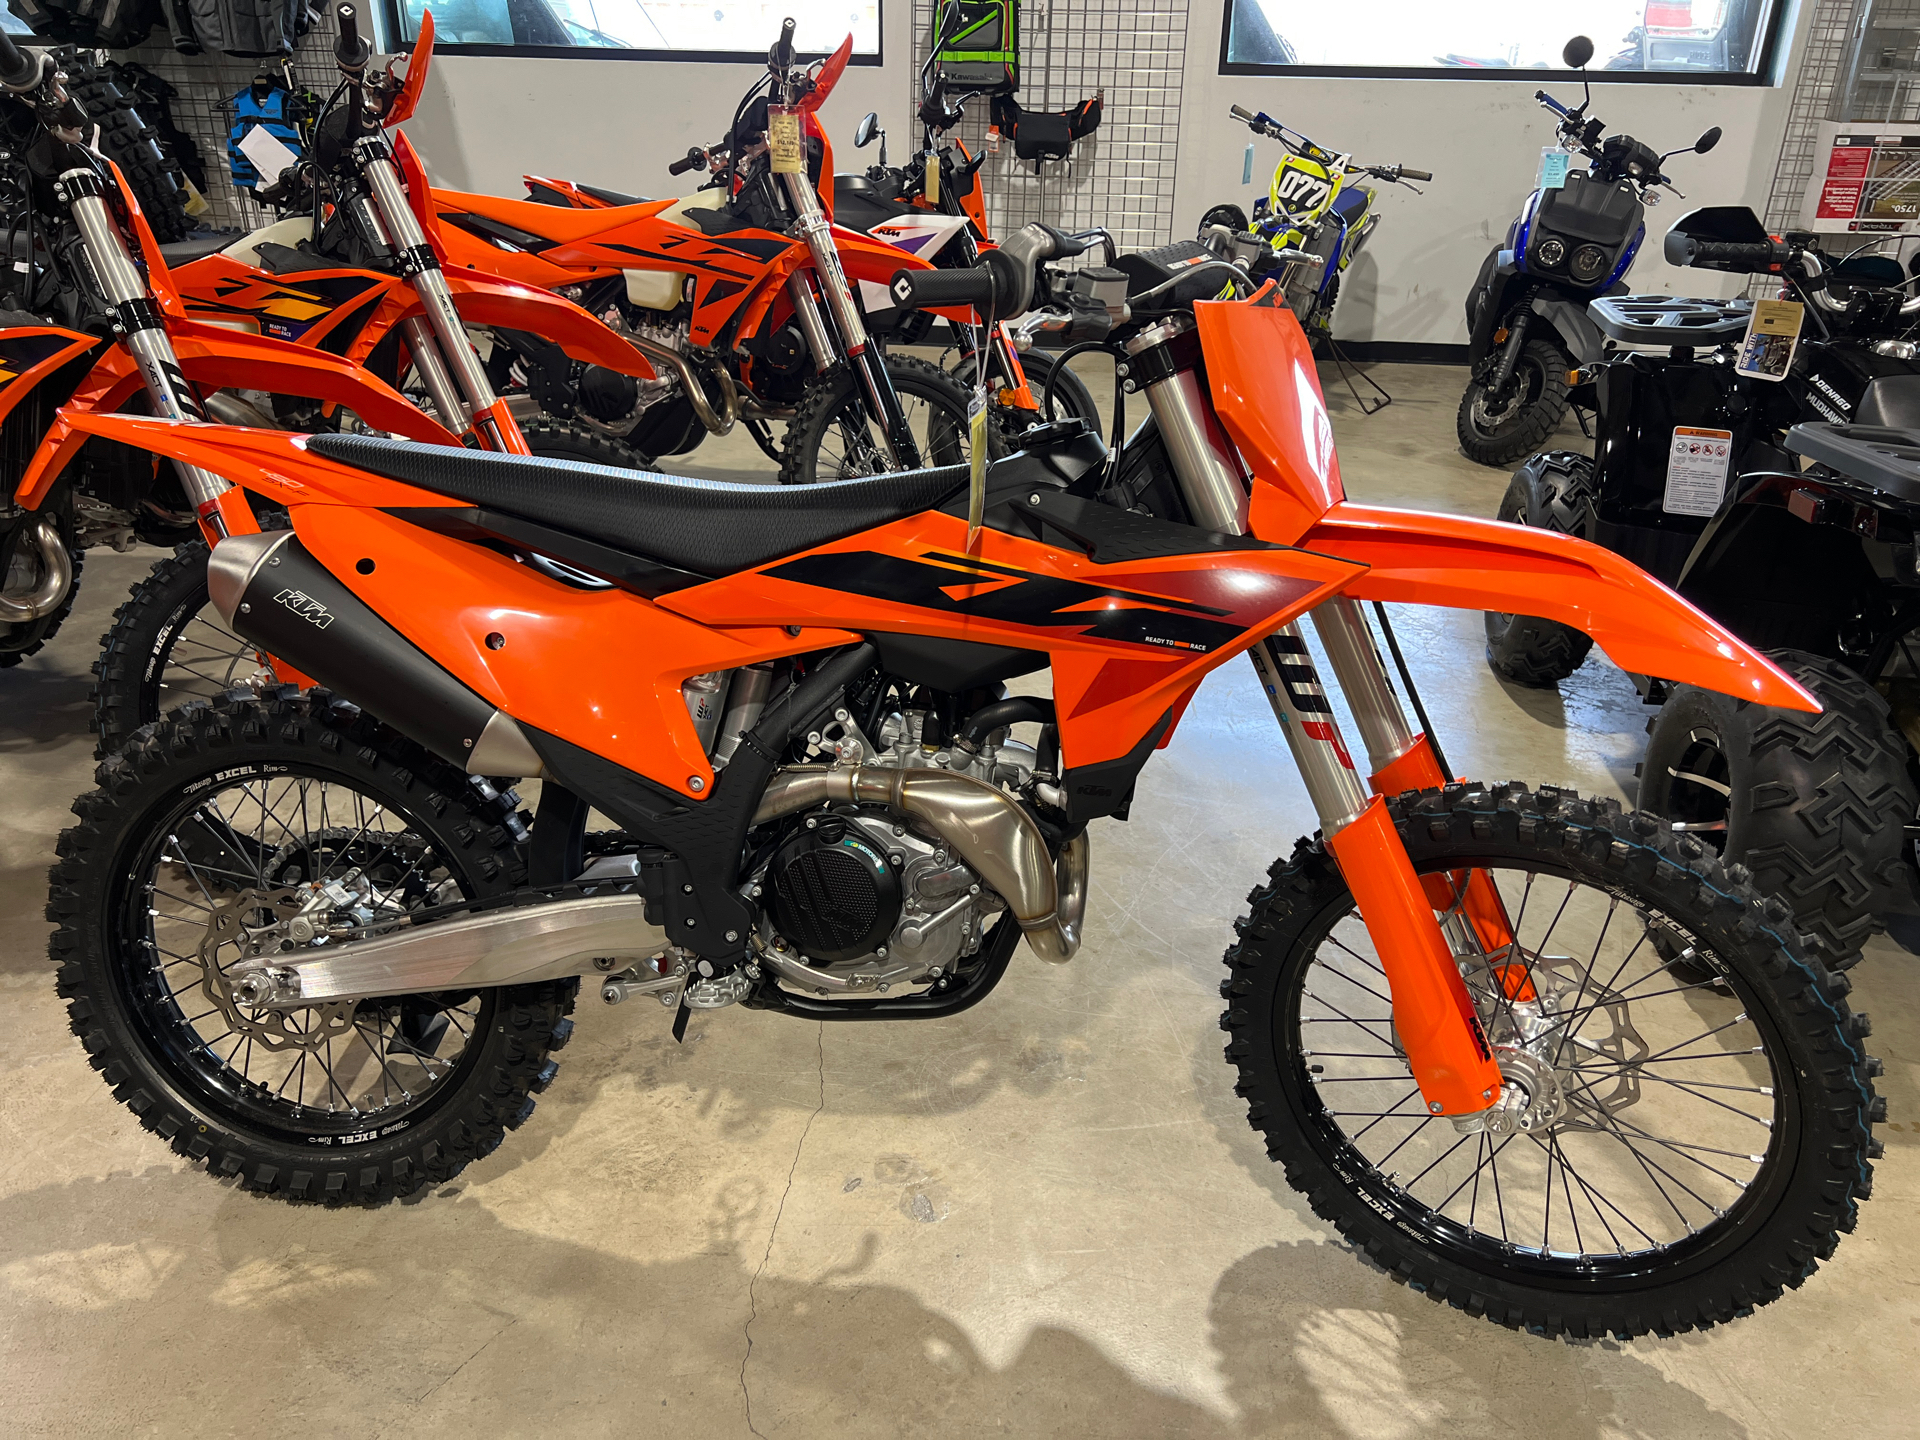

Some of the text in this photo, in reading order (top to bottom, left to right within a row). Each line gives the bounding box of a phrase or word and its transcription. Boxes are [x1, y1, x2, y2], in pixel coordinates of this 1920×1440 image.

[877, 227, 901, 238] KTM
[439, 293, 451, 313] XACT
[269, 323, 281, 331] READY
[280, 330, 292, 338] RACE
[694, 325, 709, 335] KTM
[1740, 349, 1751, 370] RIDE
[145, 360, 163, 389] XACT
[1815, 379, 1852, 411] DENAGO
[1805, 391, 1846, 425] MUDHAW
[258, 468, 305, 489] 450
[273, 588, 335, 630] KTM
[152, 624, 174, 656] EXCEL
[1144, 635, 1166, 645] READY
[1189, 643, 1207, 651] RACE
[214, 765, 257, 782] EXCEL
[263, 764, 283, 774] Rim
[1076, 784, 1113, 797] KTM
[1648, 908, 1698, 946] EXCEL
[1702, 949, 1724, 969] Rim
[1468, 1017, 1492, 1063] KTM
[314, 1136, 332, 1146] Rim
[338, 1129, 378, 1145] EXCEL
[1337, 1167, 1354, 1186] Rim
[1356, 1186, 1396, 1222] EXCEL
